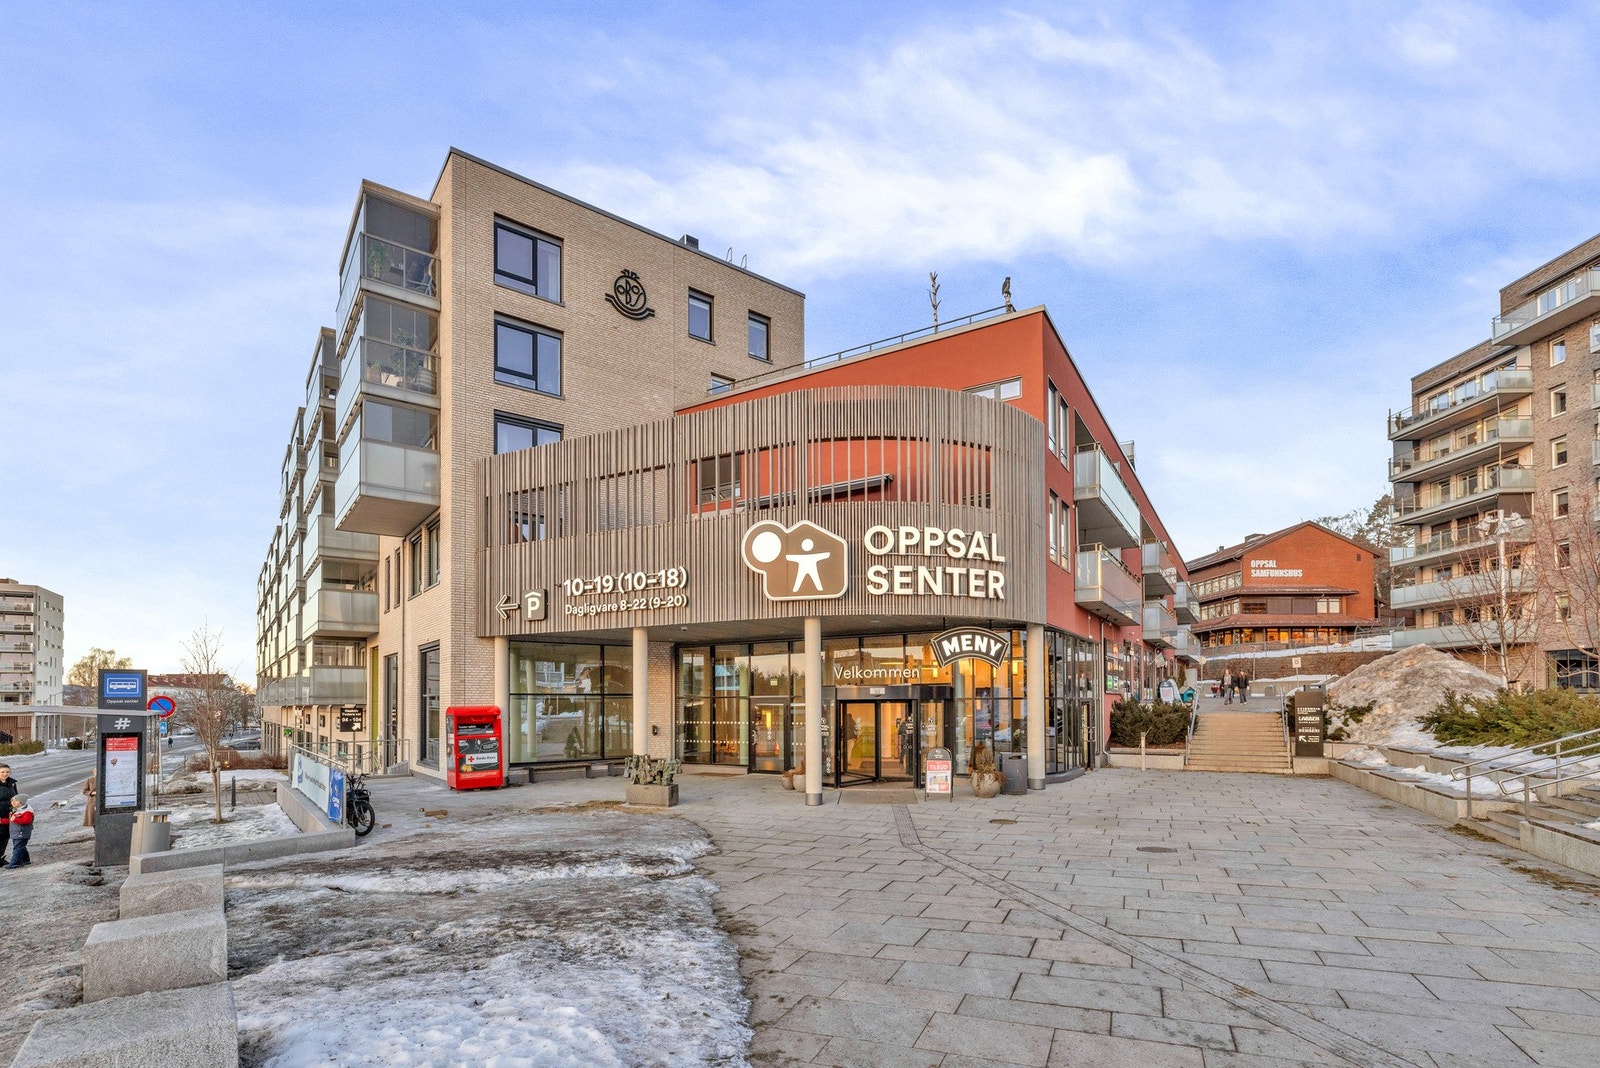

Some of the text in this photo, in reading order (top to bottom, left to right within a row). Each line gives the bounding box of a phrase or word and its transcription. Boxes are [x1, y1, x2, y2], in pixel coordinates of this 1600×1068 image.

[864, 525, 1006, 563] OPPSAL
[1250, 560, 1277, 568] OPPSAL
[1251, 569, 1303, 577] SAMFUNNSHUS
[563, 565, 688, 597] 10-19 (10-18)
[866, 564, 1005, 600] SENTER
[527, 597, 541, 619] P
[565, 594, 688, 617] Dagligvare 8-22 (9-20)
[941, 634, 1003, 658] MENY
[834, 665, 920, 680] Velkommen
